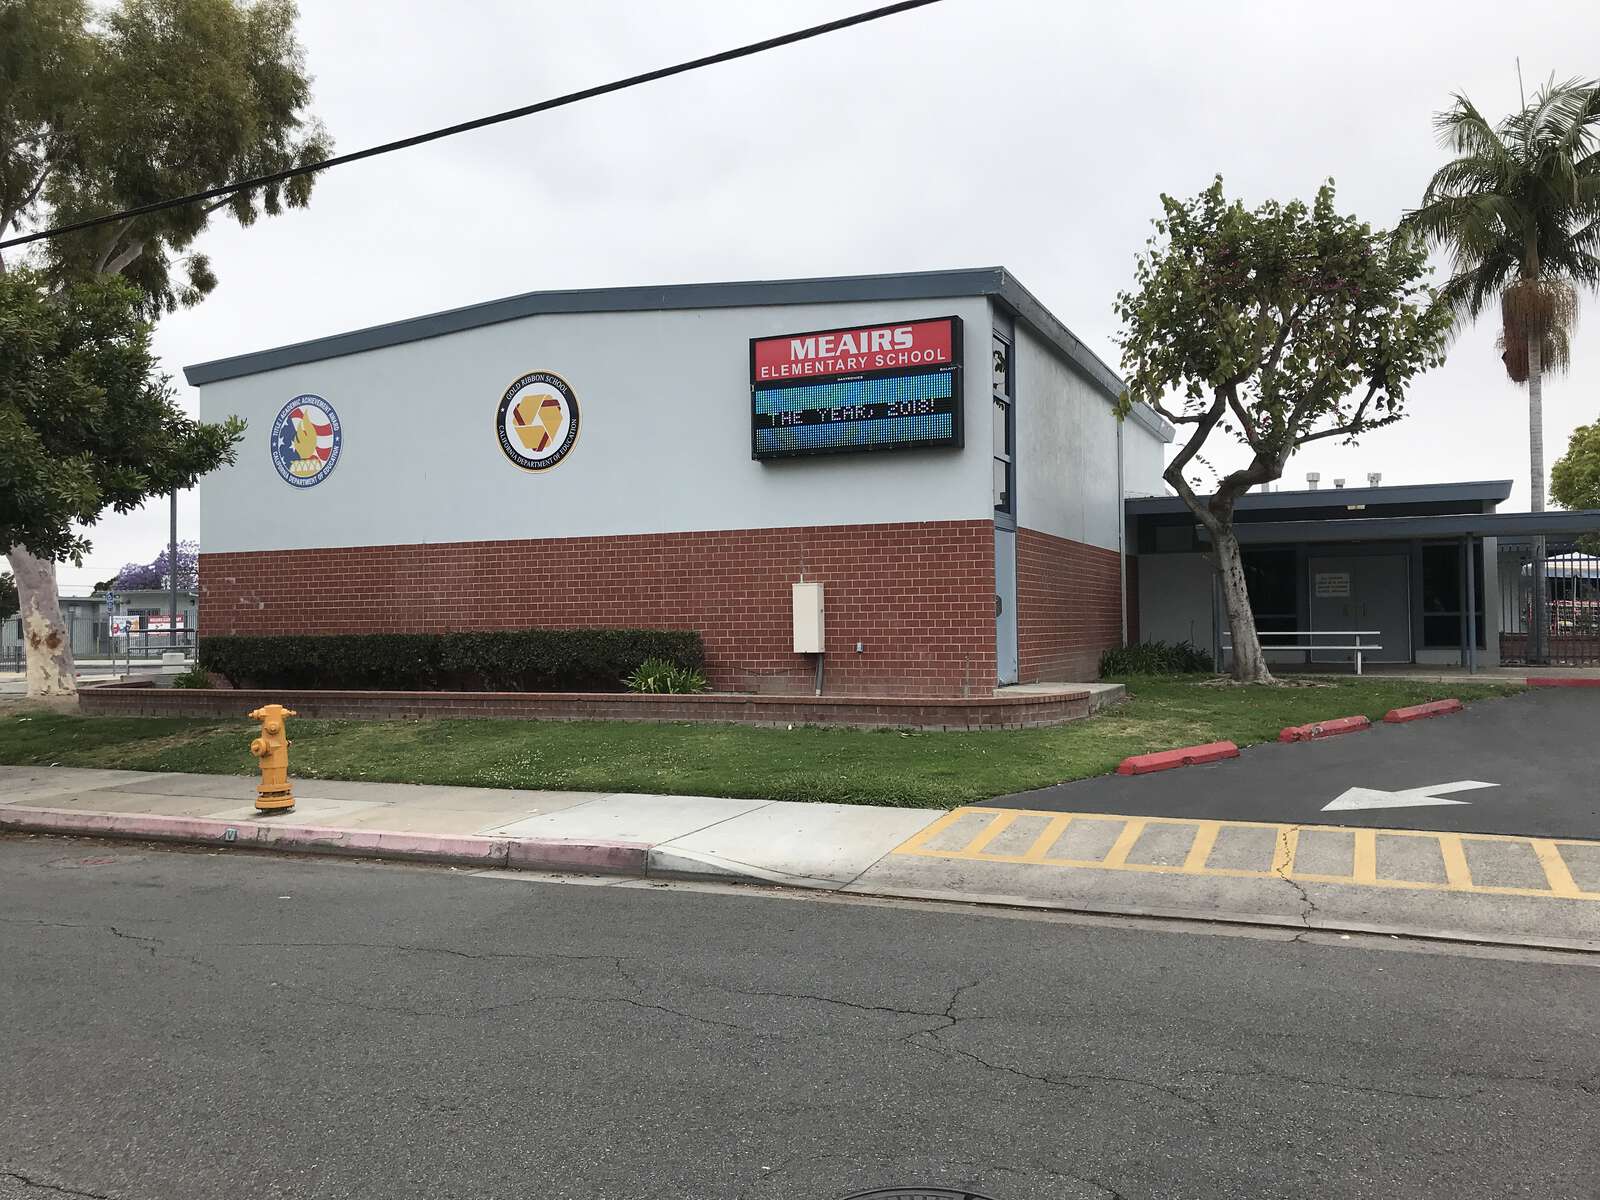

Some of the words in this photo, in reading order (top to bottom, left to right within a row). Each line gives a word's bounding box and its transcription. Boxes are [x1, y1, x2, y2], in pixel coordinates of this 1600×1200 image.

[791, 327, 913, 360] MEAIRS
[761, 356, 869, 378] ELEMENTARY
[876, 348, 946, 367] SCHOOL
[506, 383, 521, 400] GOLD
[521, 374, 545, 386] RIBBON
[545, 375, 568, 394] SCHOOL
[301, 396, 331, 414] ACHIEVEMENT
[328, 411, 340, 431] AWARD
[768, 411, 803, 426] THE
[499, 425, 518, 461] CALIFORNIA
[516, 456, 553, 468] DEPARTMENT
[553, 454, 561, 463] OF
[560, 418, 577, 455] EDUCATION
[272, 451, 289, 479] CALIFORNIA
[288, 474, 318, 486] DEPARTMENT
[323, 445, 339, 475] EDUCATION
